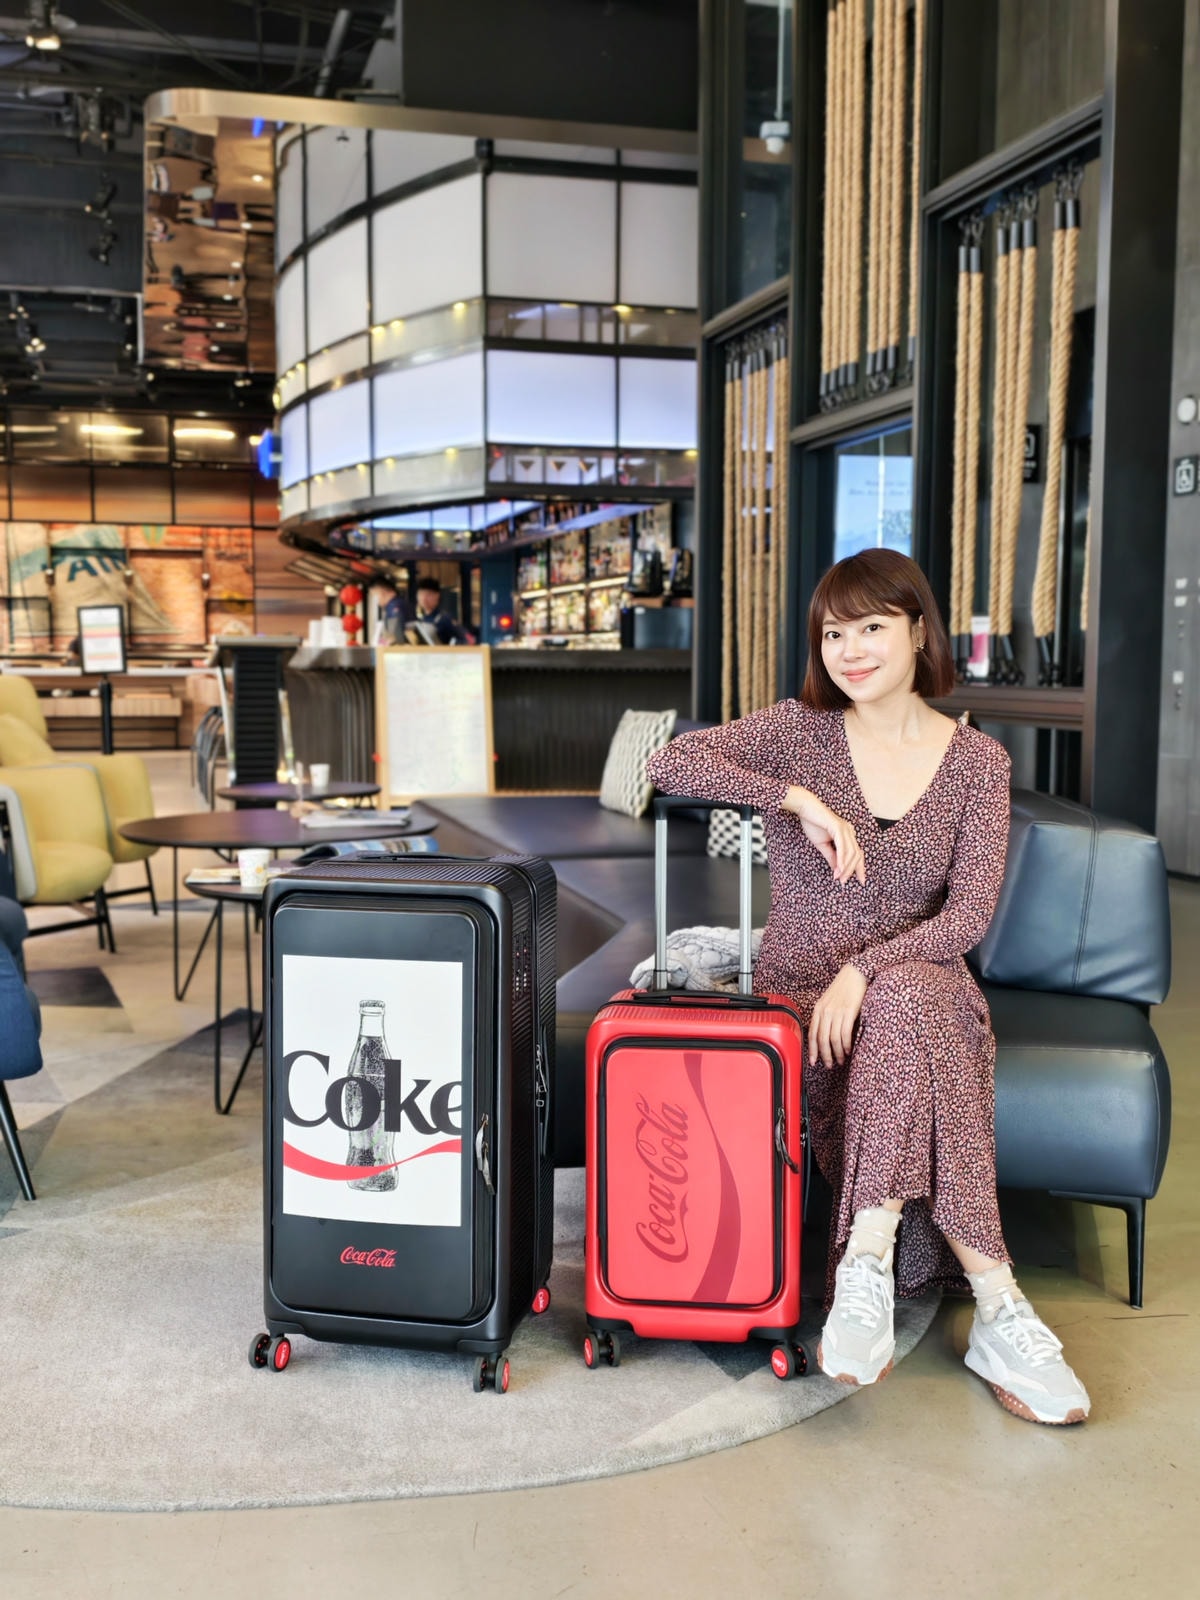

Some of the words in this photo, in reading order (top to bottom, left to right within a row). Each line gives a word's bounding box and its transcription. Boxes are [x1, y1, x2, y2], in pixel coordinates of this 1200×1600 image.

[283, 1050, 462, 1136] Coke
[636, 1092, 689, 1263] Coca-Cola
[340, 1246, 398, 1267] Coca-Cola
